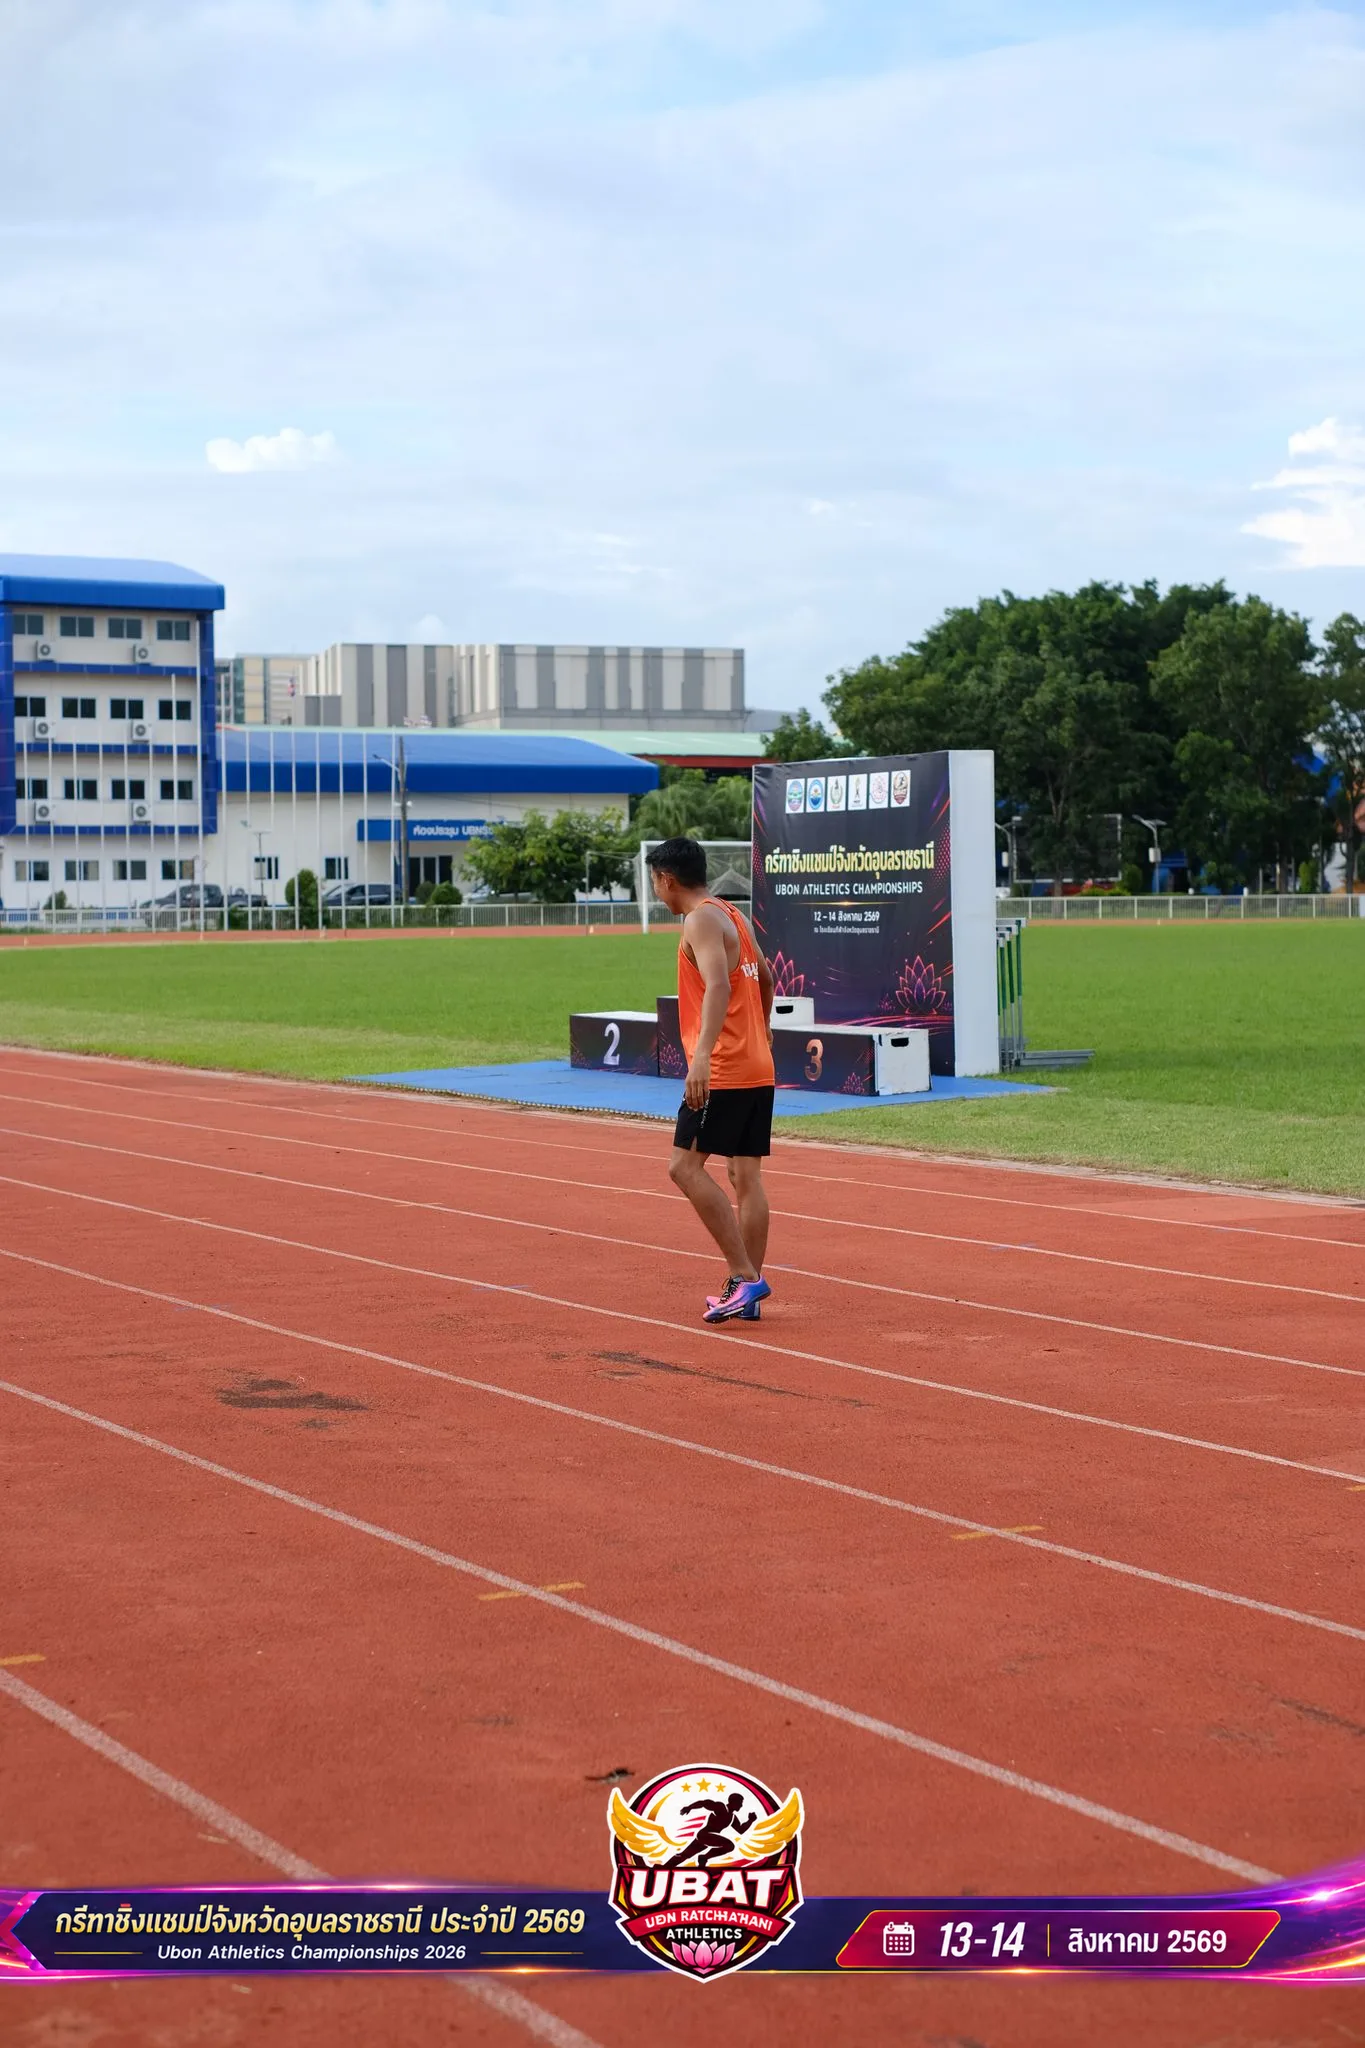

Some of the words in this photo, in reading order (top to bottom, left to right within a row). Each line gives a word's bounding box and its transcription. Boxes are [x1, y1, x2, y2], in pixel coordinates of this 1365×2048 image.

[775, 883, 800, 896] UBON
[803, 882, 850, 896] ATHLETICS
[852, 881, 923, 895] CHAMPIONSHIPS
[814, 911, 822, 922] 12
[828, 911, 836, 922] 14
[838, 910, 863, 922] สิงหาคม
[864, 911, 880, 922] 2569
[603, 1022, 621, 1066] 2
[804, 1038, 824, 1082] 3
